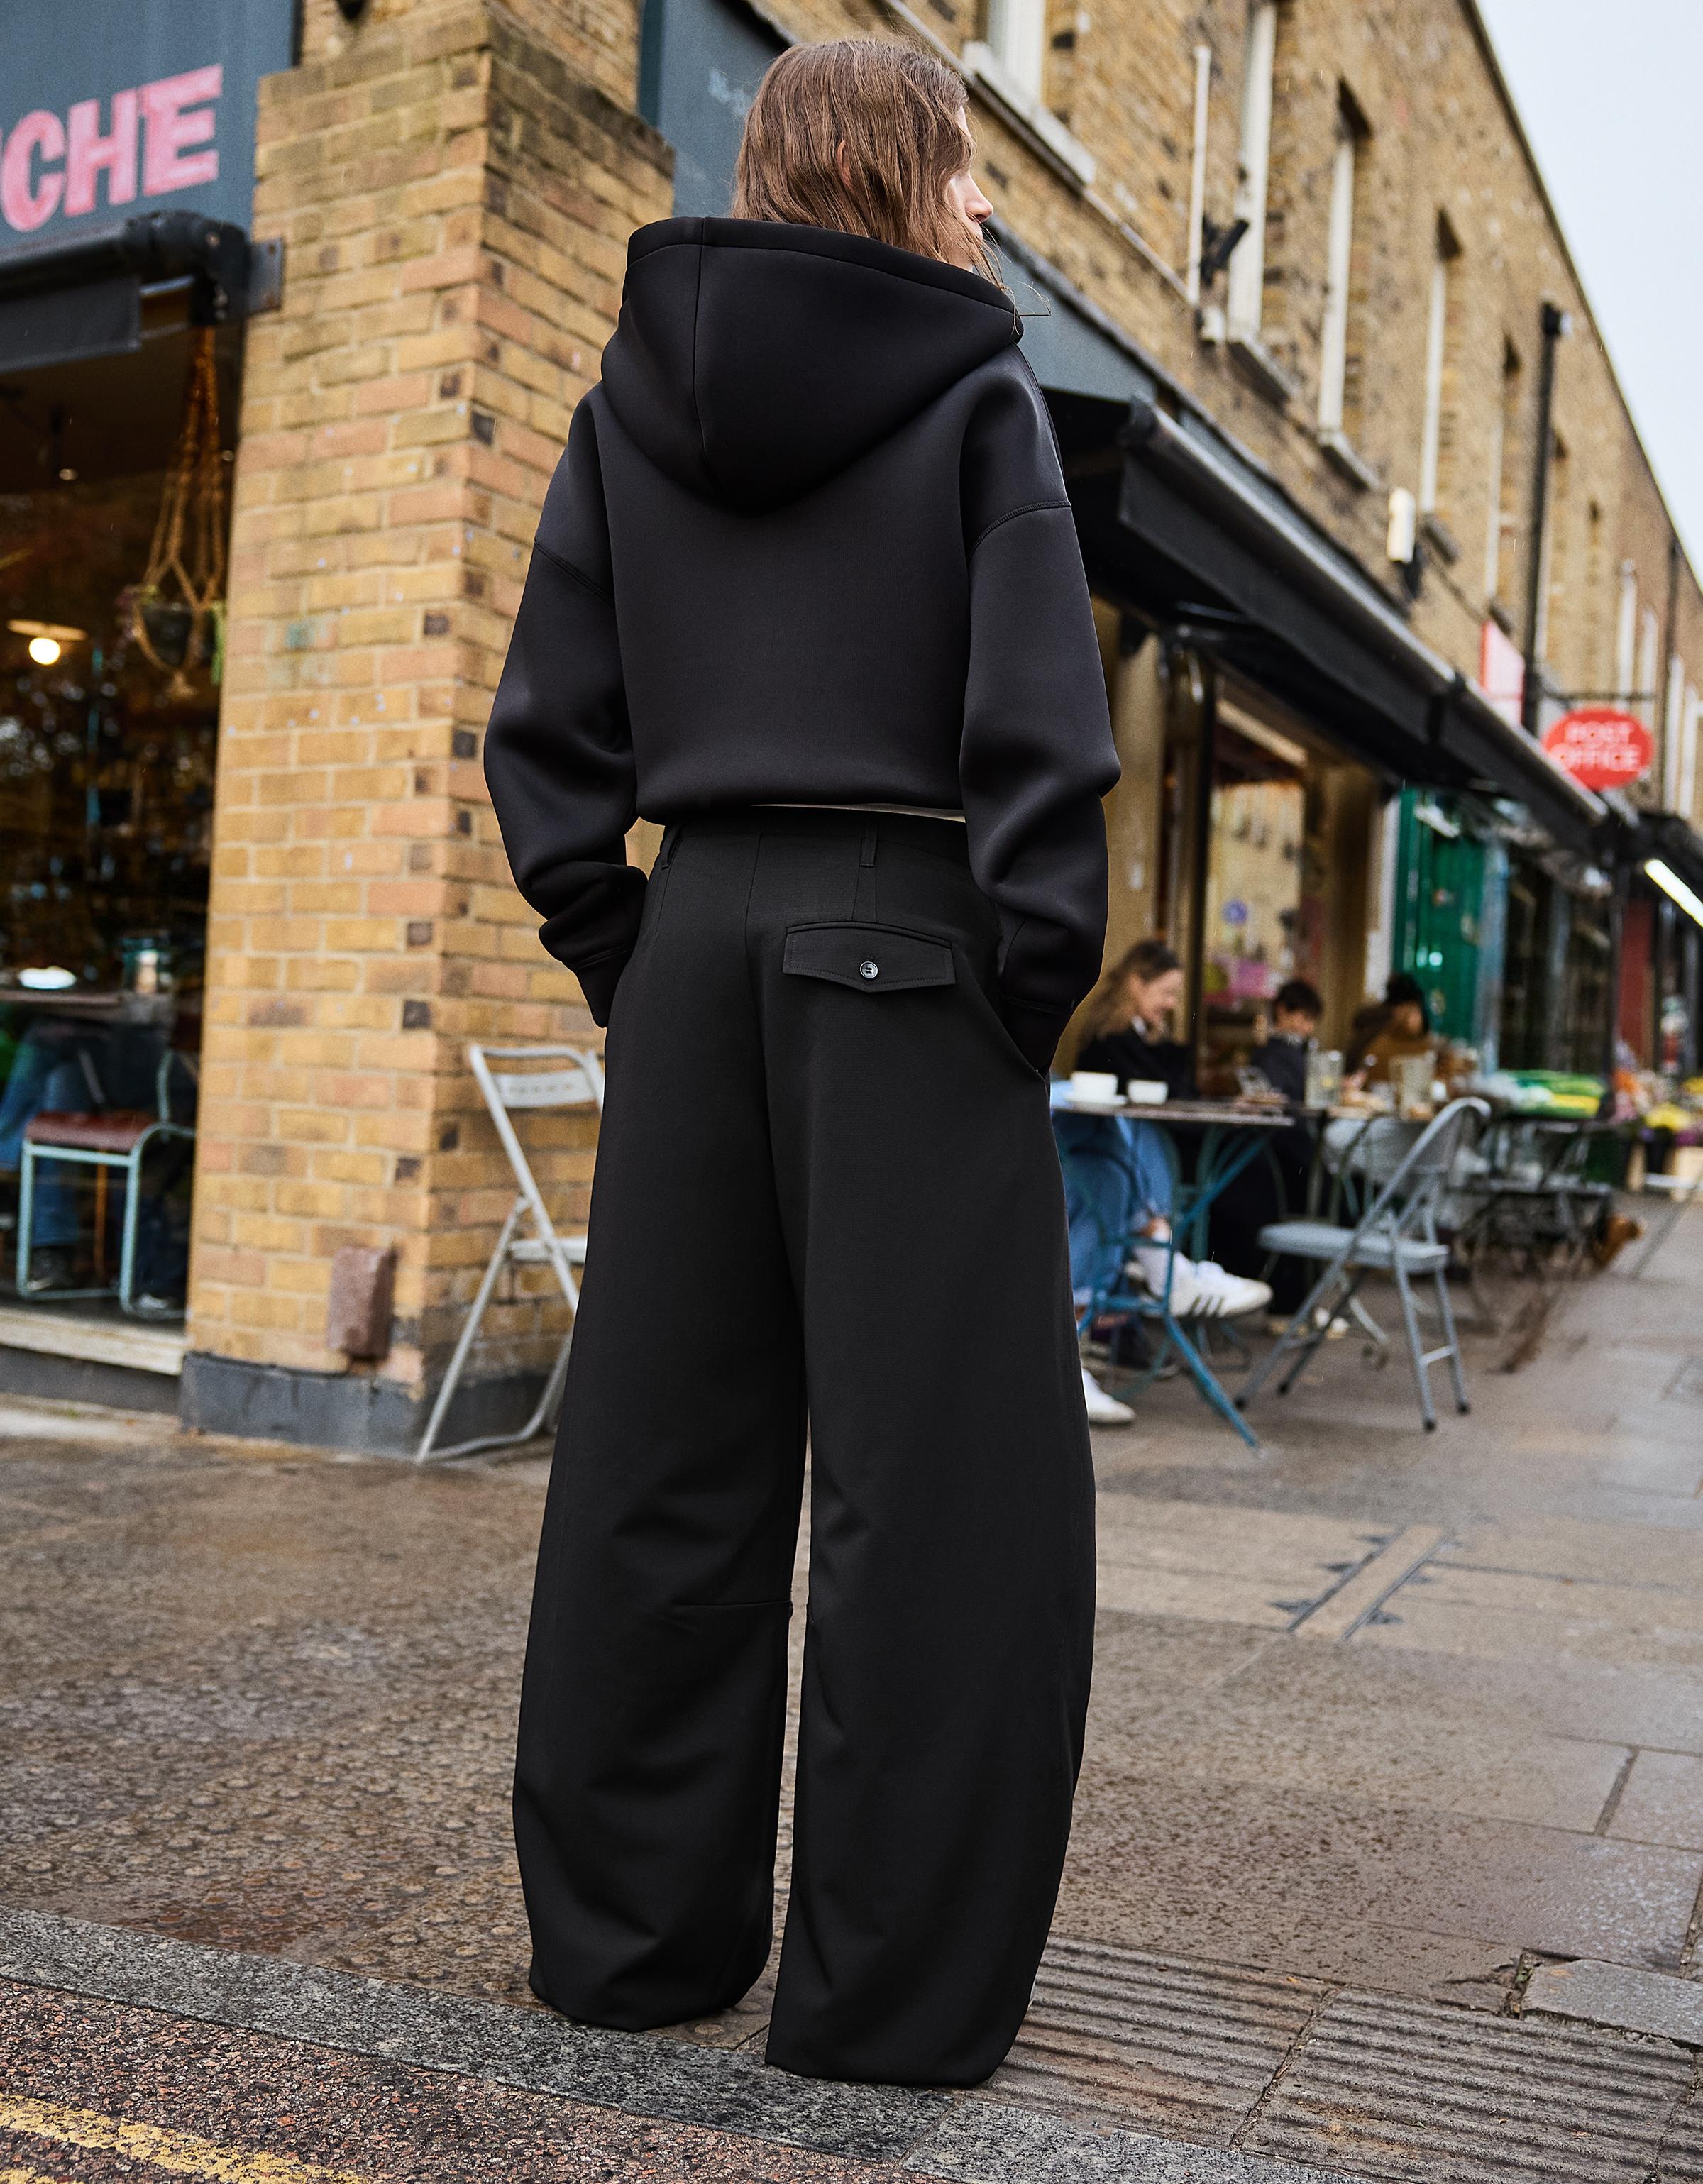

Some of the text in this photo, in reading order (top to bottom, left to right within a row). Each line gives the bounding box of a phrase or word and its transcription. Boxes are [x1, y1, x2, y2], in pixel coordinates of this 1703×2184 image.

[0, 64, 223, 231] CHE
[1565, 721, 1633, 745] POST
[1549, 744, 1641, 771] OFFICE
